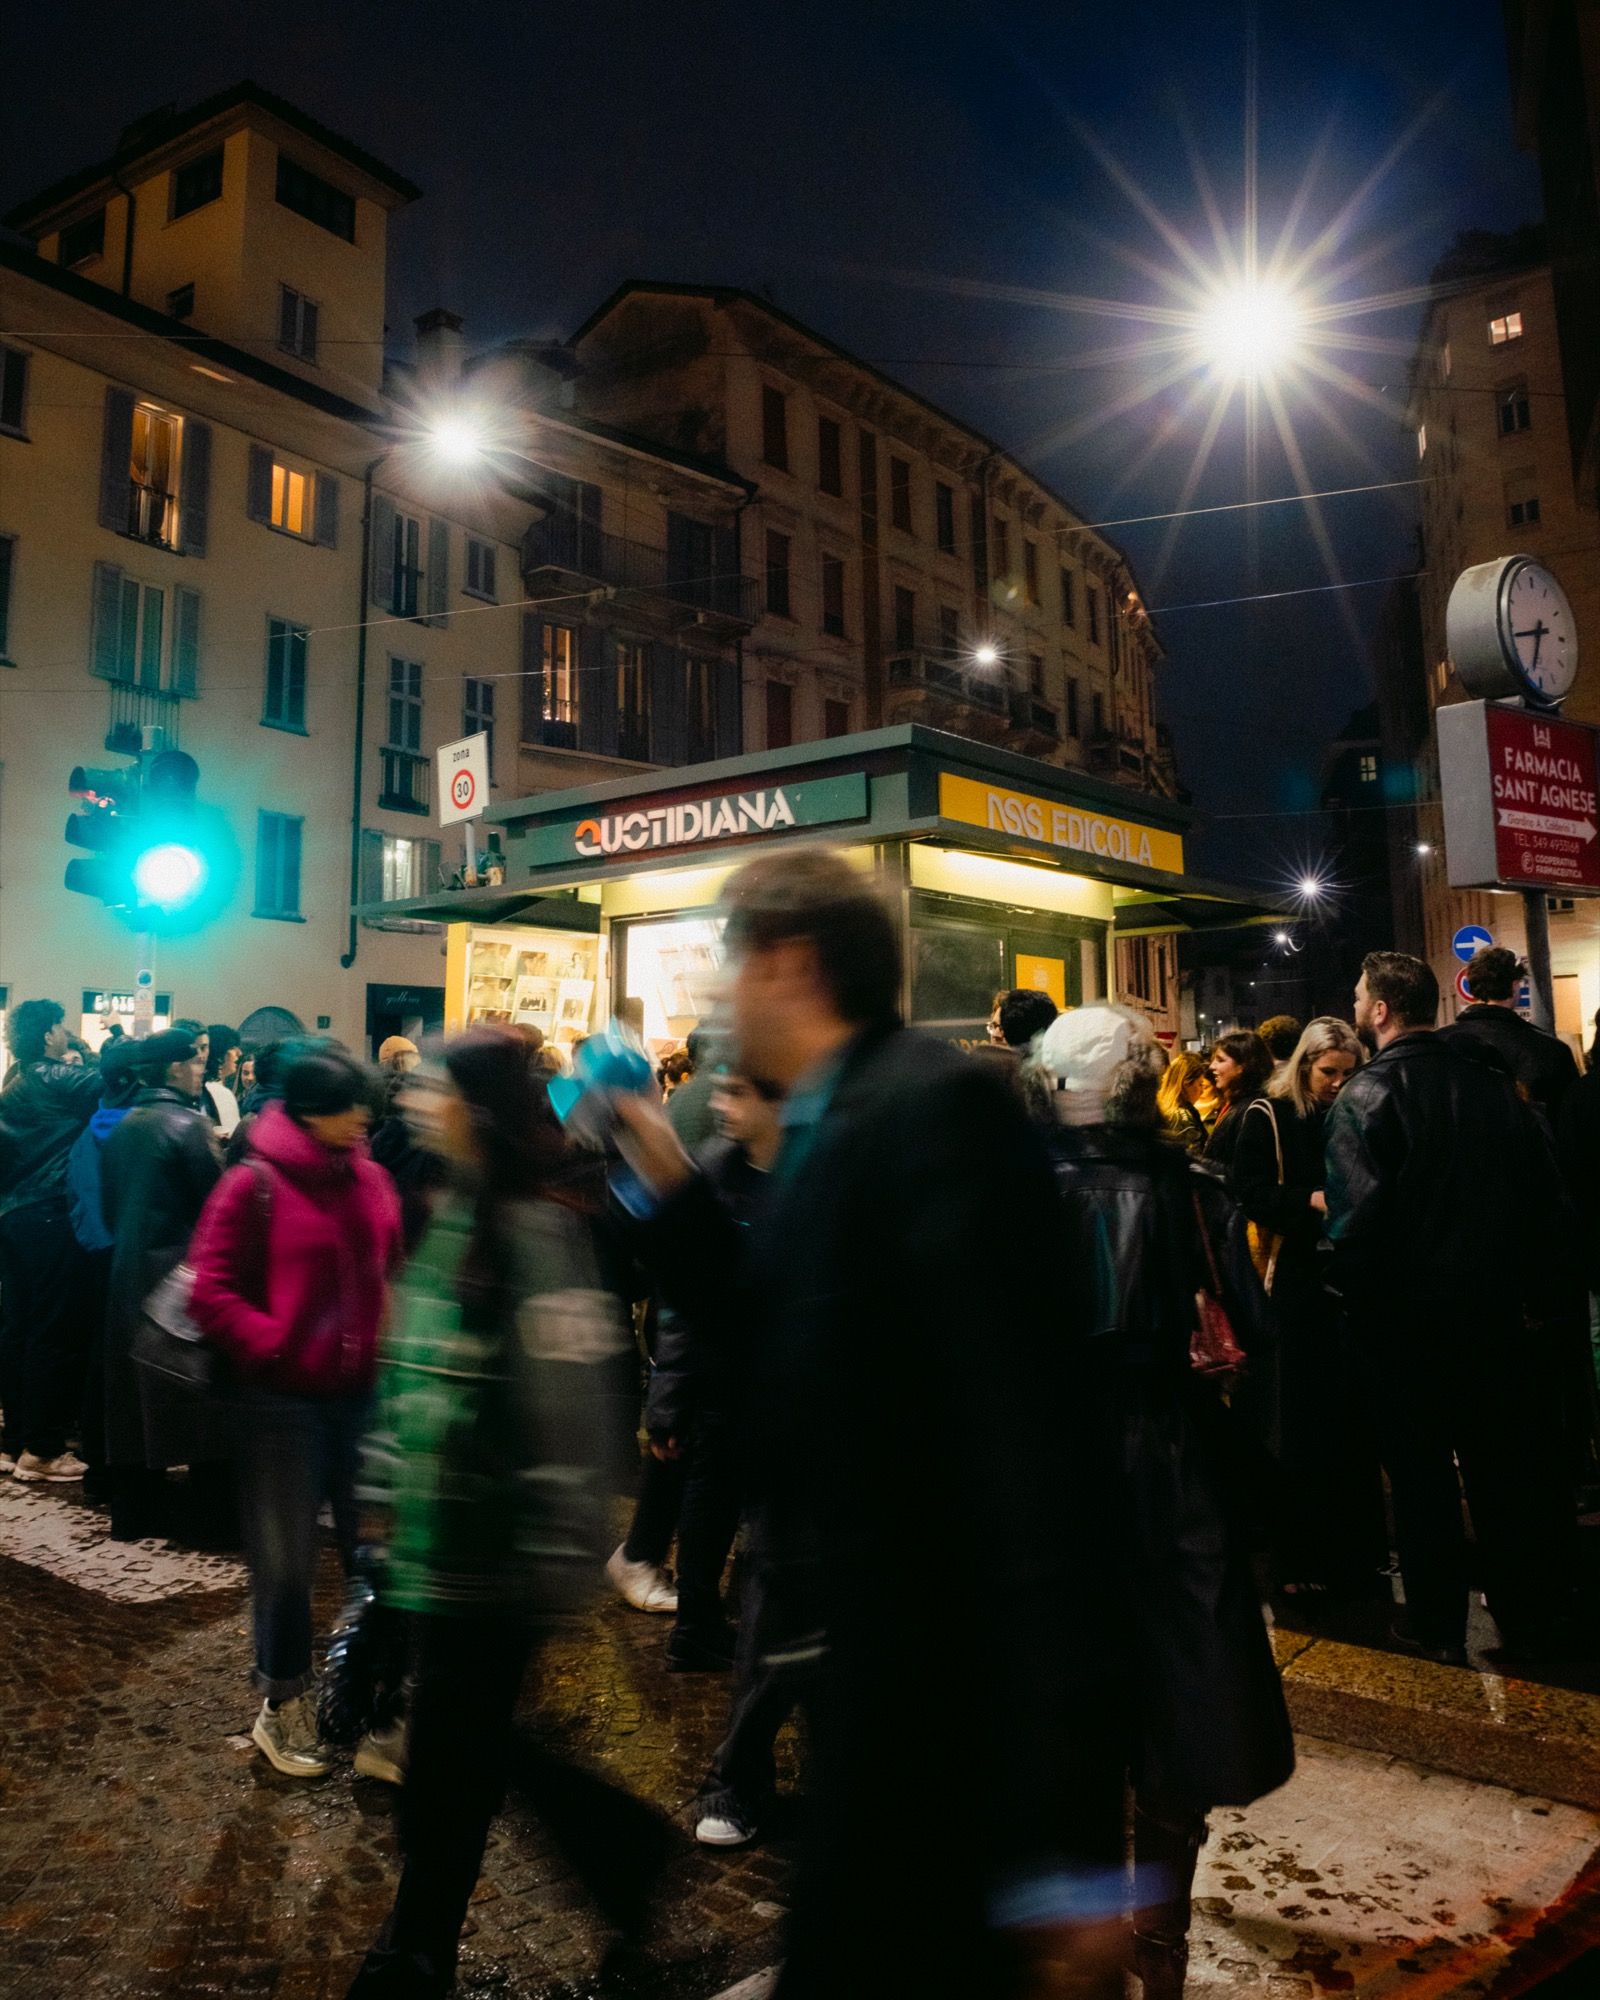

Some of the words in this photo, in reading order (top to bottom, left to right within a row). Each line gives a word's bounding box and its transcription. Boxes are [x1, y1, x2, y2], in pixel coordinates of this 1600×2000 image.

[453, 748, 470, 762] zona
[1504, 747, 1583, 783] FARMACIA
[457, 781, 470, 798] 30
[1494, 775, 1597, 814] SANT'AGNESE
[575, 788, 796, 857] QUOTIDIANA
[1052, 809, 1153, 867] EDICOLA
